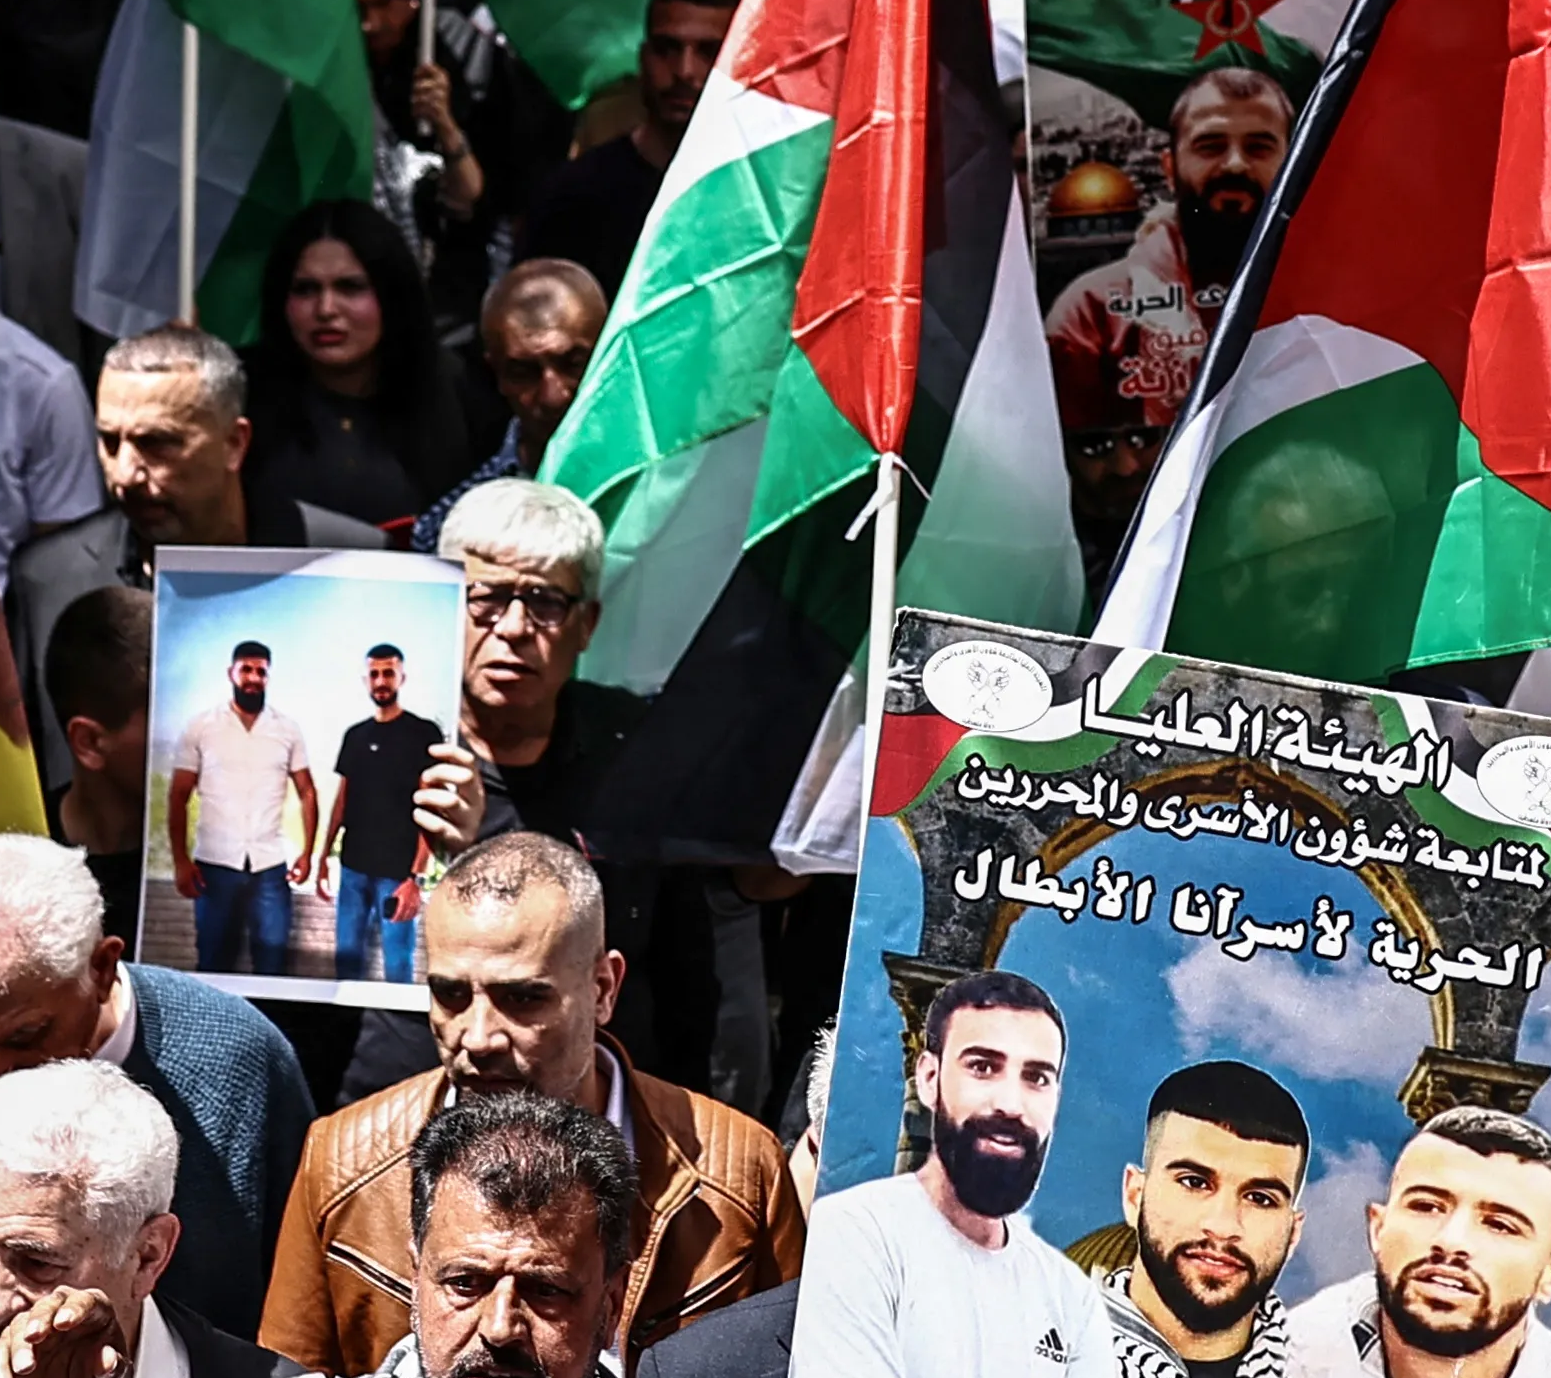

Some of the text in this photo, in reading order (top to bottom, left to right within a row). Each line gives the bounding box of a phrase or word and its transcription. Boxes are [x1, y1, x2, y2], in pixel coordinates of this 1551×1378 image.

[1106, 282, 1187, 318] الحرية
[1271, 704, 1453, 793] الهيئة
[957, 755, 1548, 891] لمتابعة شؤون الأسرى والمحررين
[953, 847, 1547, 994] الحرية لأسرآنا الأبطال
